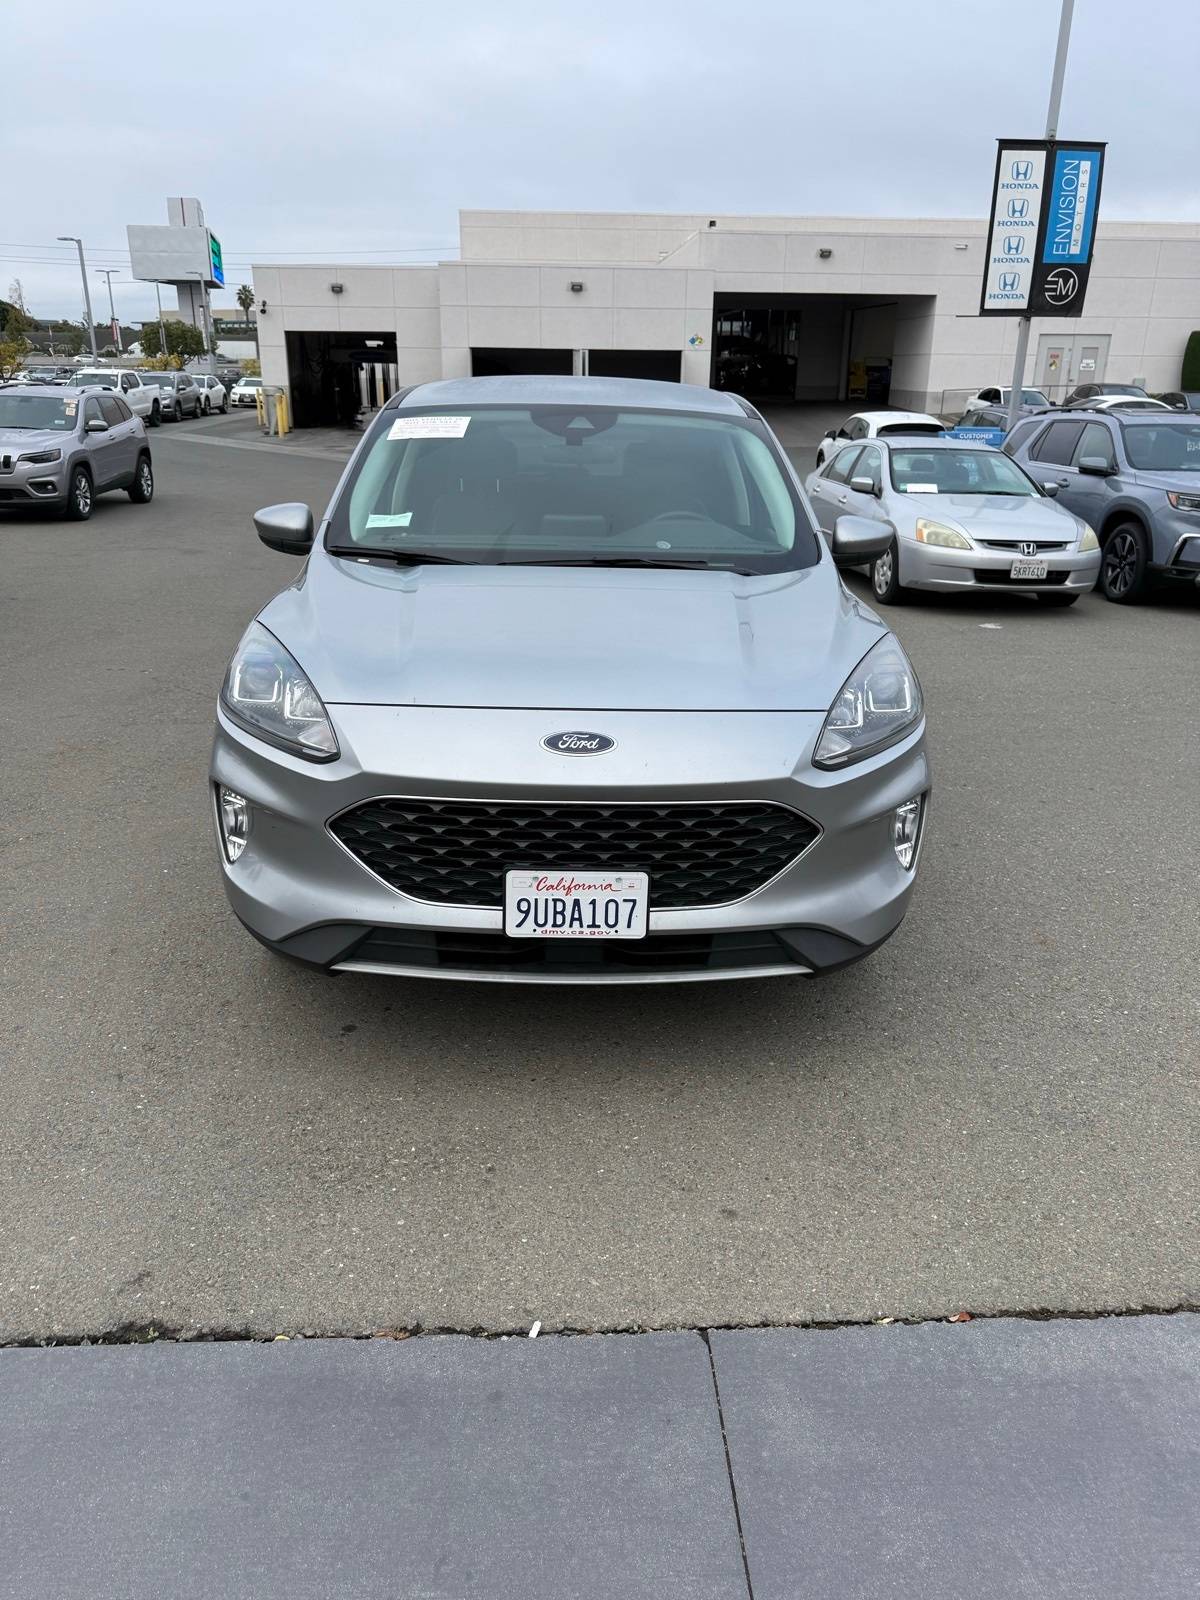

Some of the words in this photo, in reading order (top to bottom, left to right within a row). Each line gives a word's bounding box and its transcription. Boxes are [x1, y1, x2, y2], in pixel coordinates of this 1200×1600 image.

[1053, 160, 1080, 255] ENVISION
[1073, 168, 1089, 247] MOTORS
[558, 733, 599, 749] Ford
[536, 877, 621, 896] California
[515, 898, 637, 928] 9UBA107
